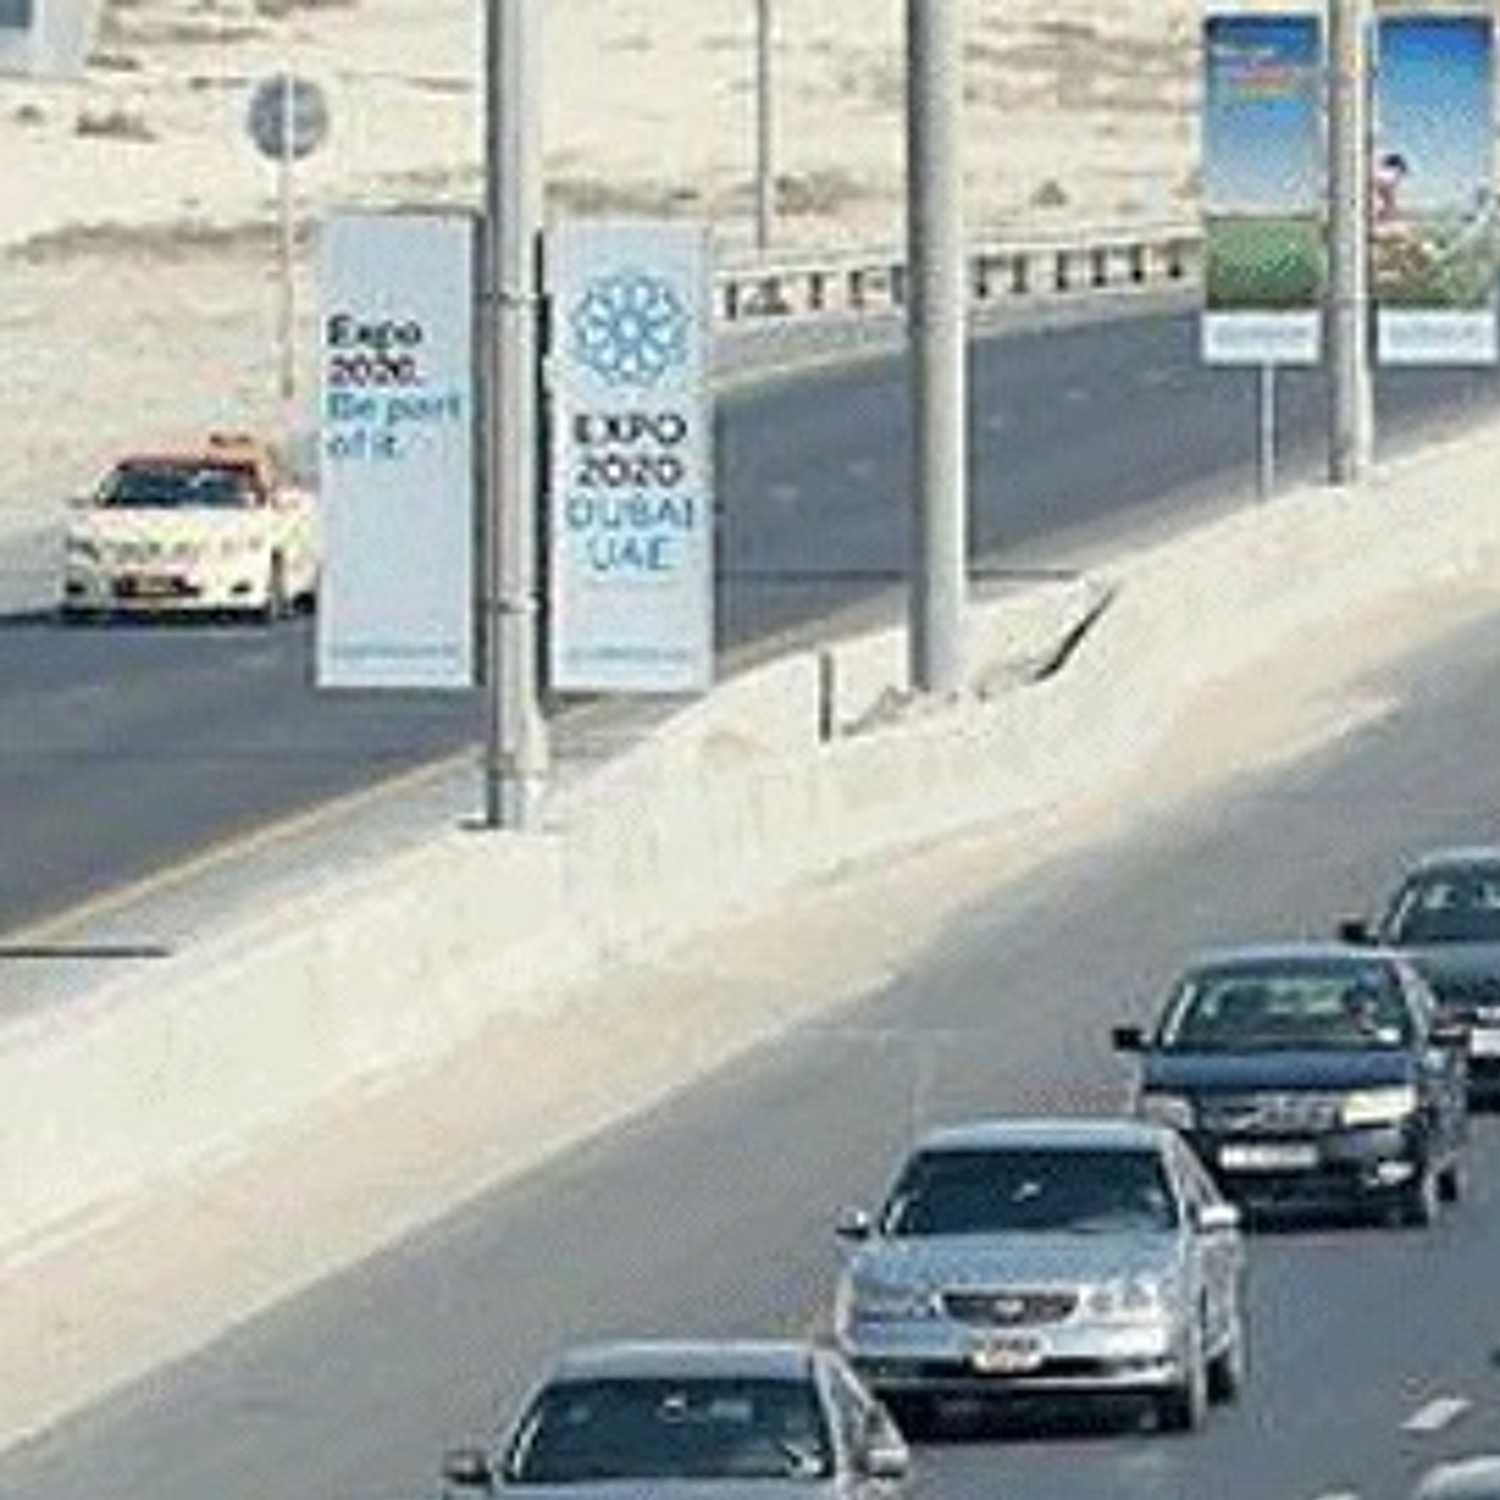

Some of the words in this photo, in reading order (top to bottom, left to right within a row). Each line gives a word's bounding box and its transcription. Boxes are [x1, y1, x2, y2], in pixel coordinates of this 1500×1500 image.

[327, 314, 422, 354] Expo
[573, 411, 688, 446] EXPO
[574, 452, 686, 488] 2020
[565, 496, 694, 532] DUBAI
[586, 536, 676, 573] UAE
